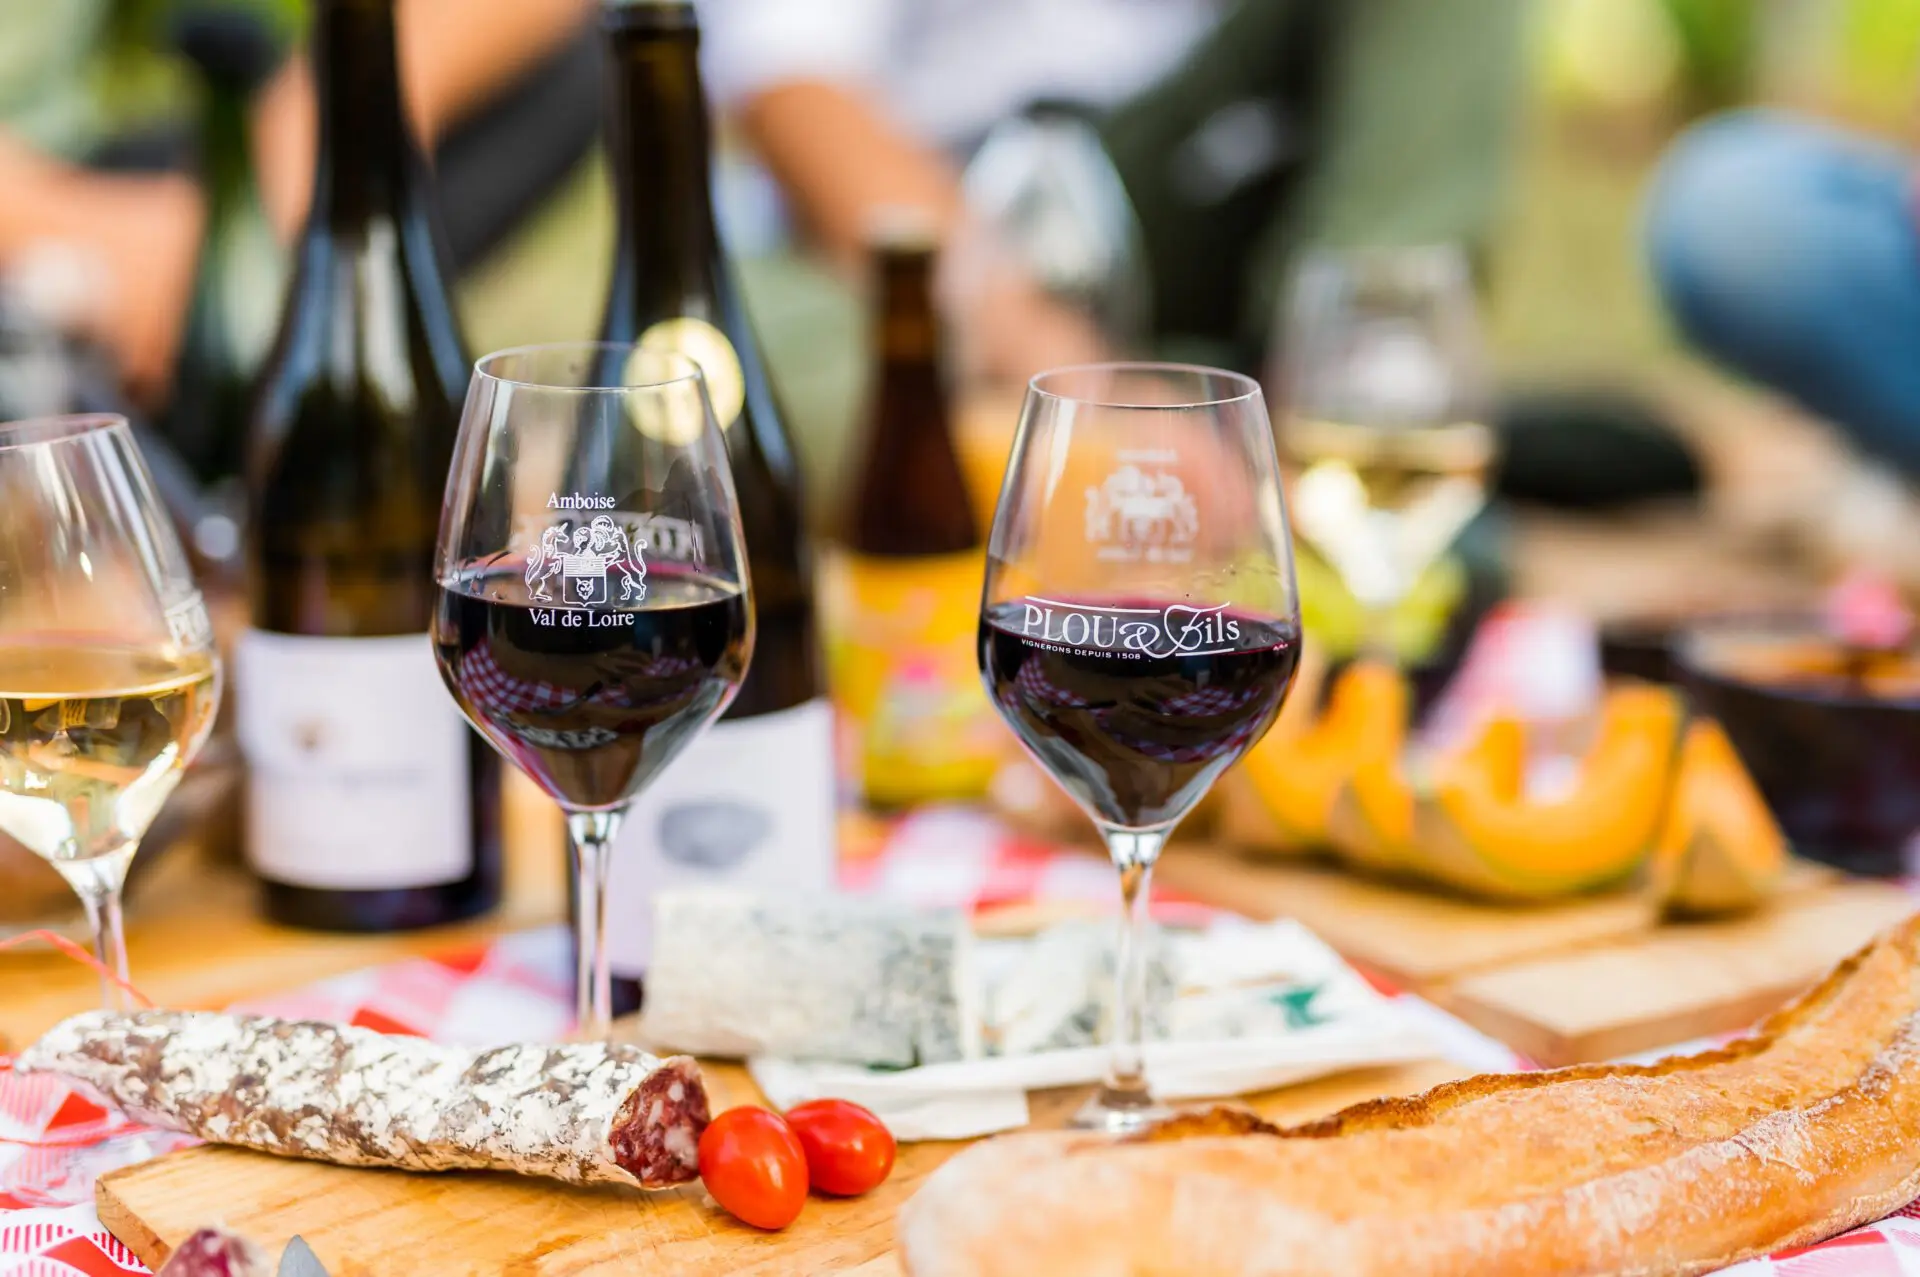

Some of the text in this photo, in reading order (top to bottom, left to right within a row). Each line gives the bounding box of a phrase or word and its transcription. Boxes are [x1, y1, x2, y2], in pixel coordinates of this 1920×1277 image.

[546, 491, 616, 509] Amboise
[528, 608, 635, 627] Val de Loire
[1021, 603, 1118, 648] PLOU
[1164, 601, 1240, 651] Fils
[1021, 638, 1141, 660] VIGNERONS DEPUIS 1508
